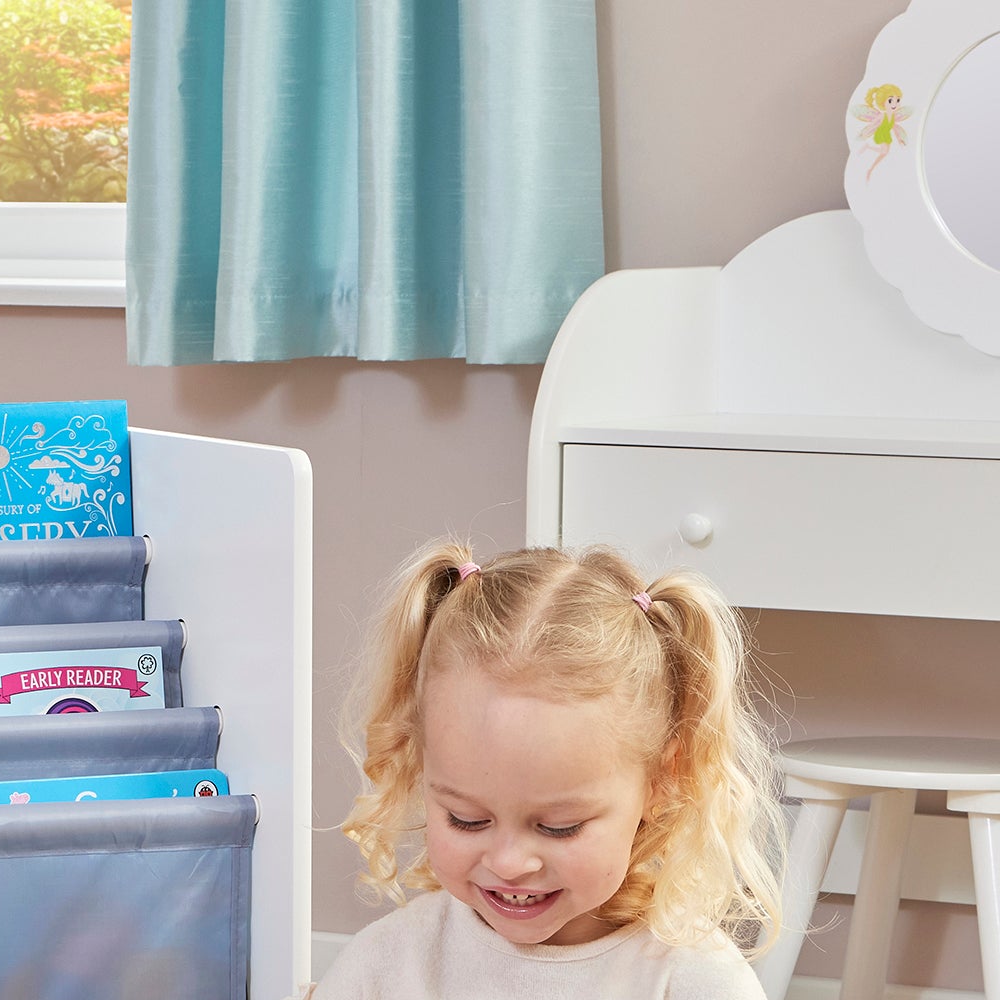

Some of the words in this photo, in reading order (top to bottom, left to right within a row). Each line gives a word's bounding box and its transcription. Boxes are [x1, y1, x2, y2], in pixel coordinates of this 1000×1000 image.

[27, 503, 42, 514] OF
[20, 670, 63, 690] EARLY
[66, 670, 122, 686] READER
